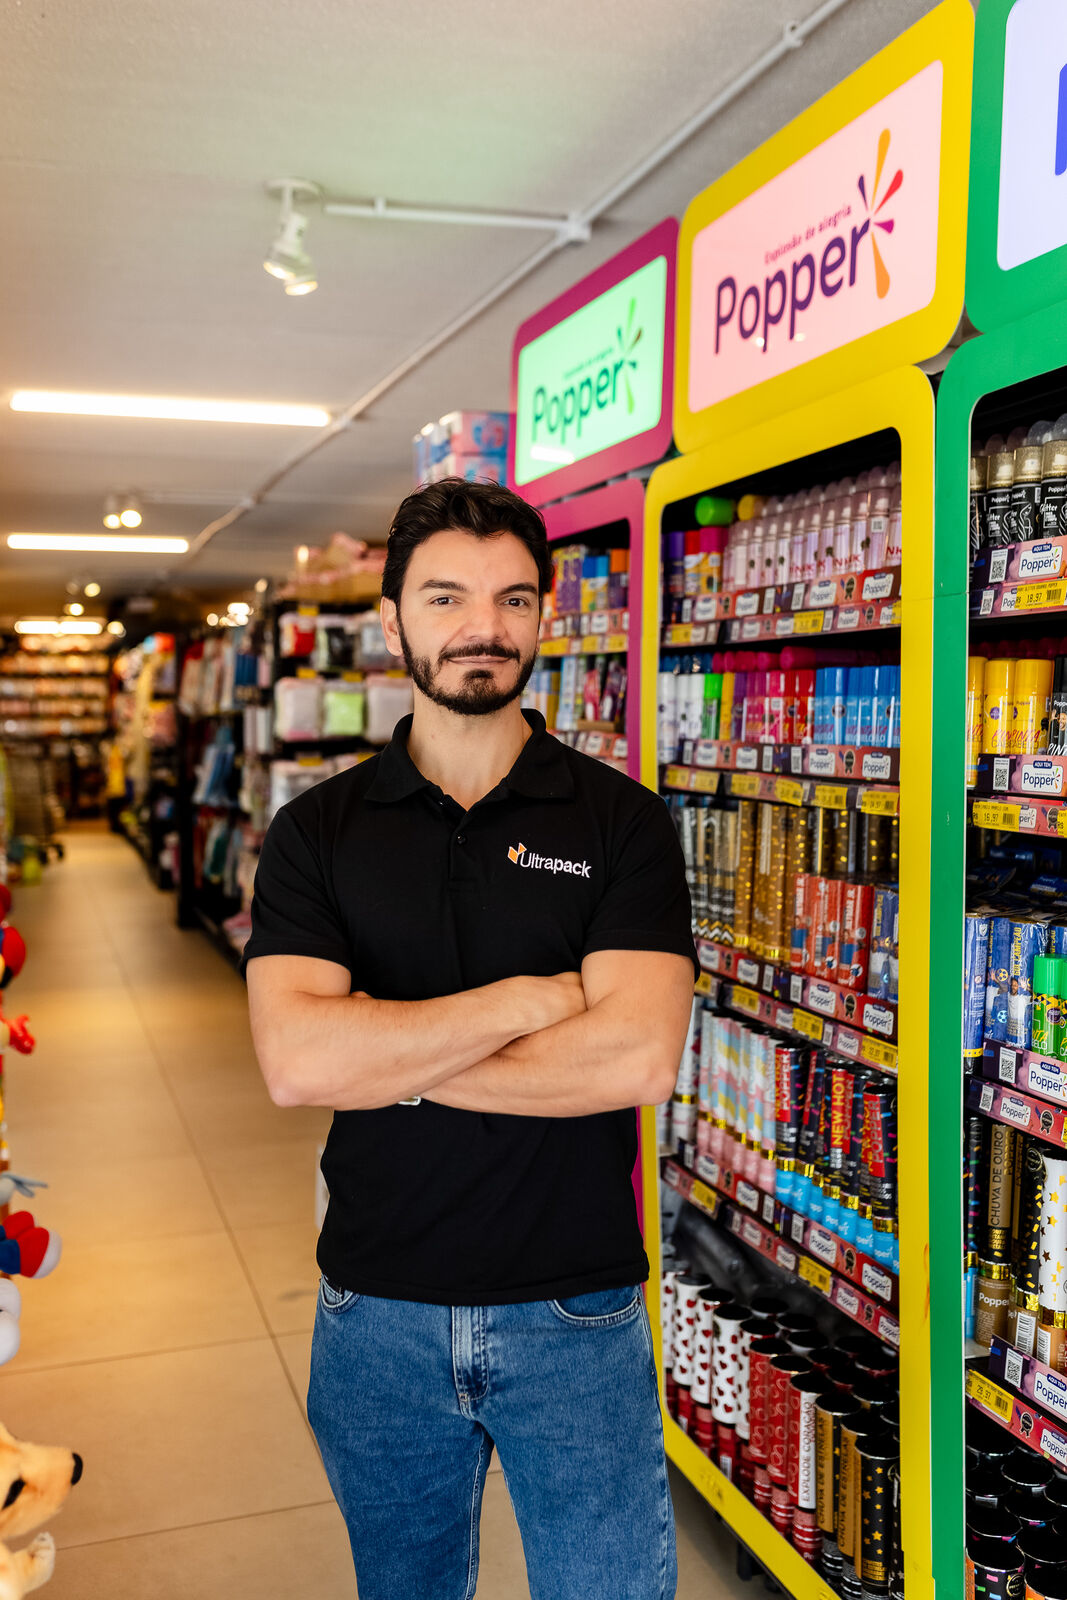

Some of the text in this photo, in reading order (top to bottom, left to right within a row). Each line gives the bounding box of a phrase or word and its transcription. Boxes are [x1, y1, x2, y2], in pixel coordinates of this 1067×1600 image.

[714, 218, 871, 355] Popper
[532, 359, 624, 443] Popper
[1021, 558, 1054, 572] Popper
[864, 761, 885, 774] Popper
[1023, 772, 1056, 788] Popper
[520, 852, 592, 878] Ultrapack
[865, 1010, 888, 1027] Popper
[1031, 1071, 1063, 1092] Popper
[832, 1074, 845, 1145] NEW HOT
[1002, 1103, 1024, 1119] Popper
[868, 1101, 883, 1163] POPPER
[991, 1131, 1004, 1226] CHUVA DE OURO
[801, 1455, 810, 1502] EXPLODE
